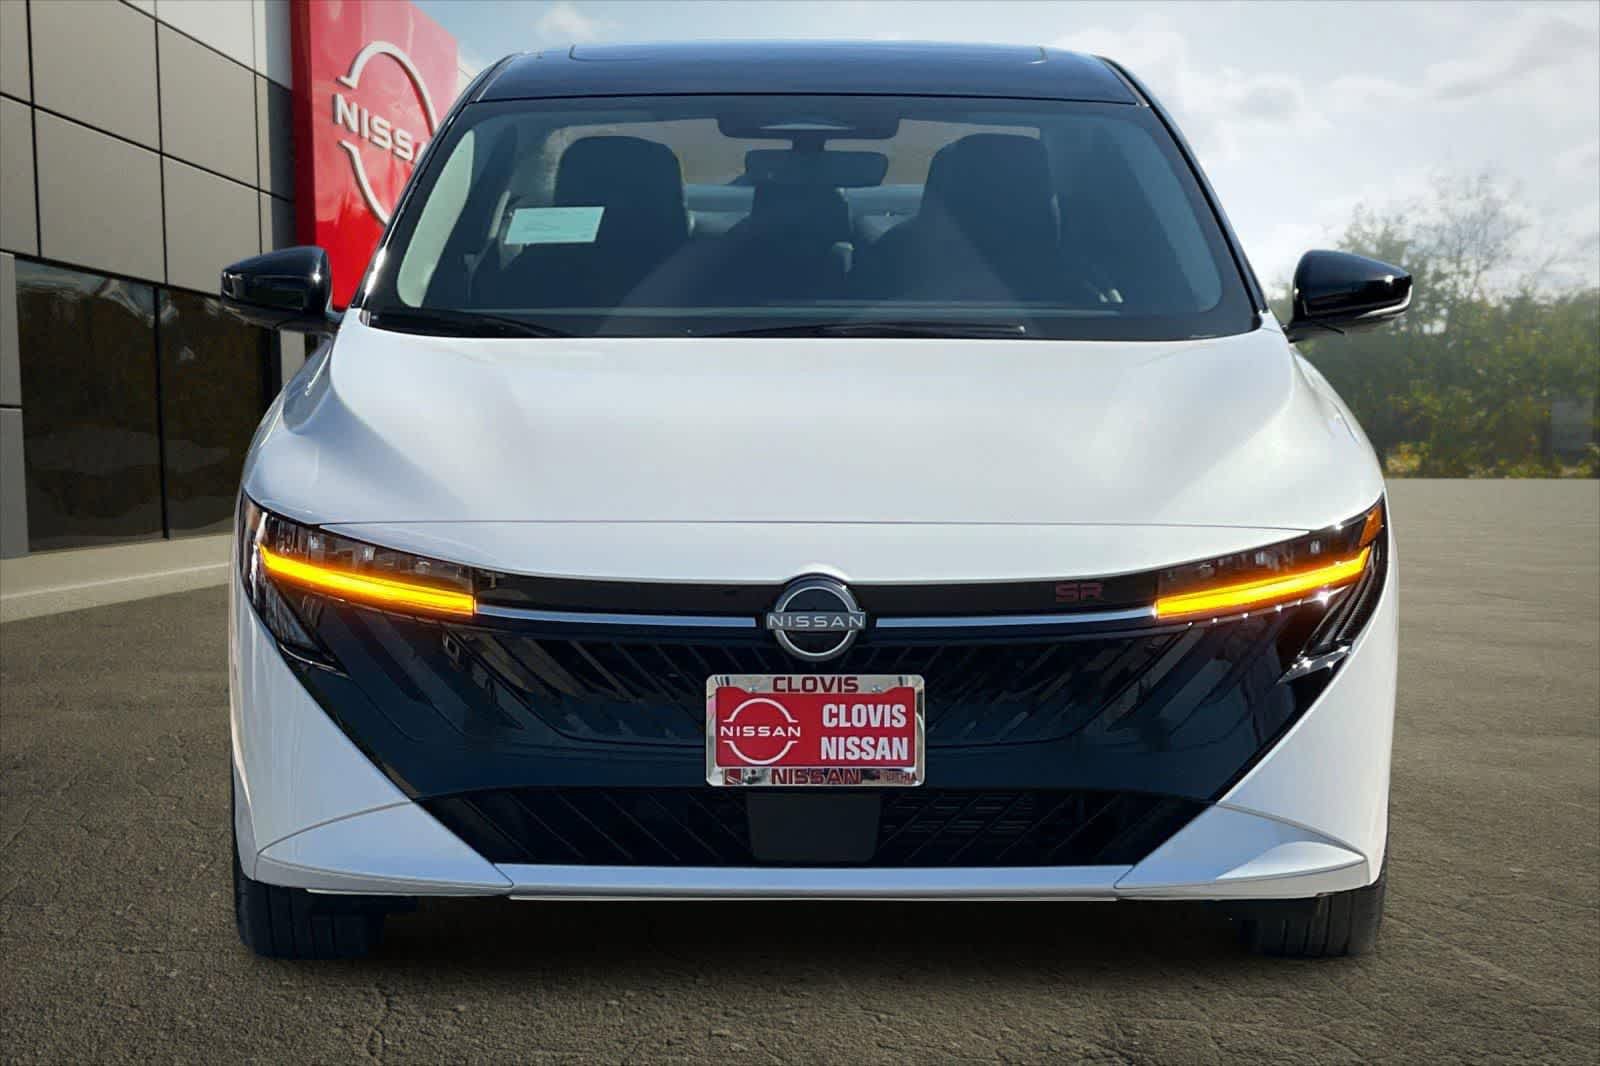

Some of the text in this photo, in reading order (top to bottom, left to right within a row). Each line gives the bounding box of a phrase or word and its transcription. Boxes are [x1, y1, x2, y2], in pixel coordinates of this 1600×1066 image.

[1056, 582, 1104, 602] SR
[769, 615, 863, 628] NISSAN
[773, 676, 858, 692] CLOVIS
[822, 704, 907, 728] CLOVIS
[720, 726, 801, 737] NISSAN
[820, 736, 908, 761] NISSAN
[771, 768, 862, 785] NISSAN
